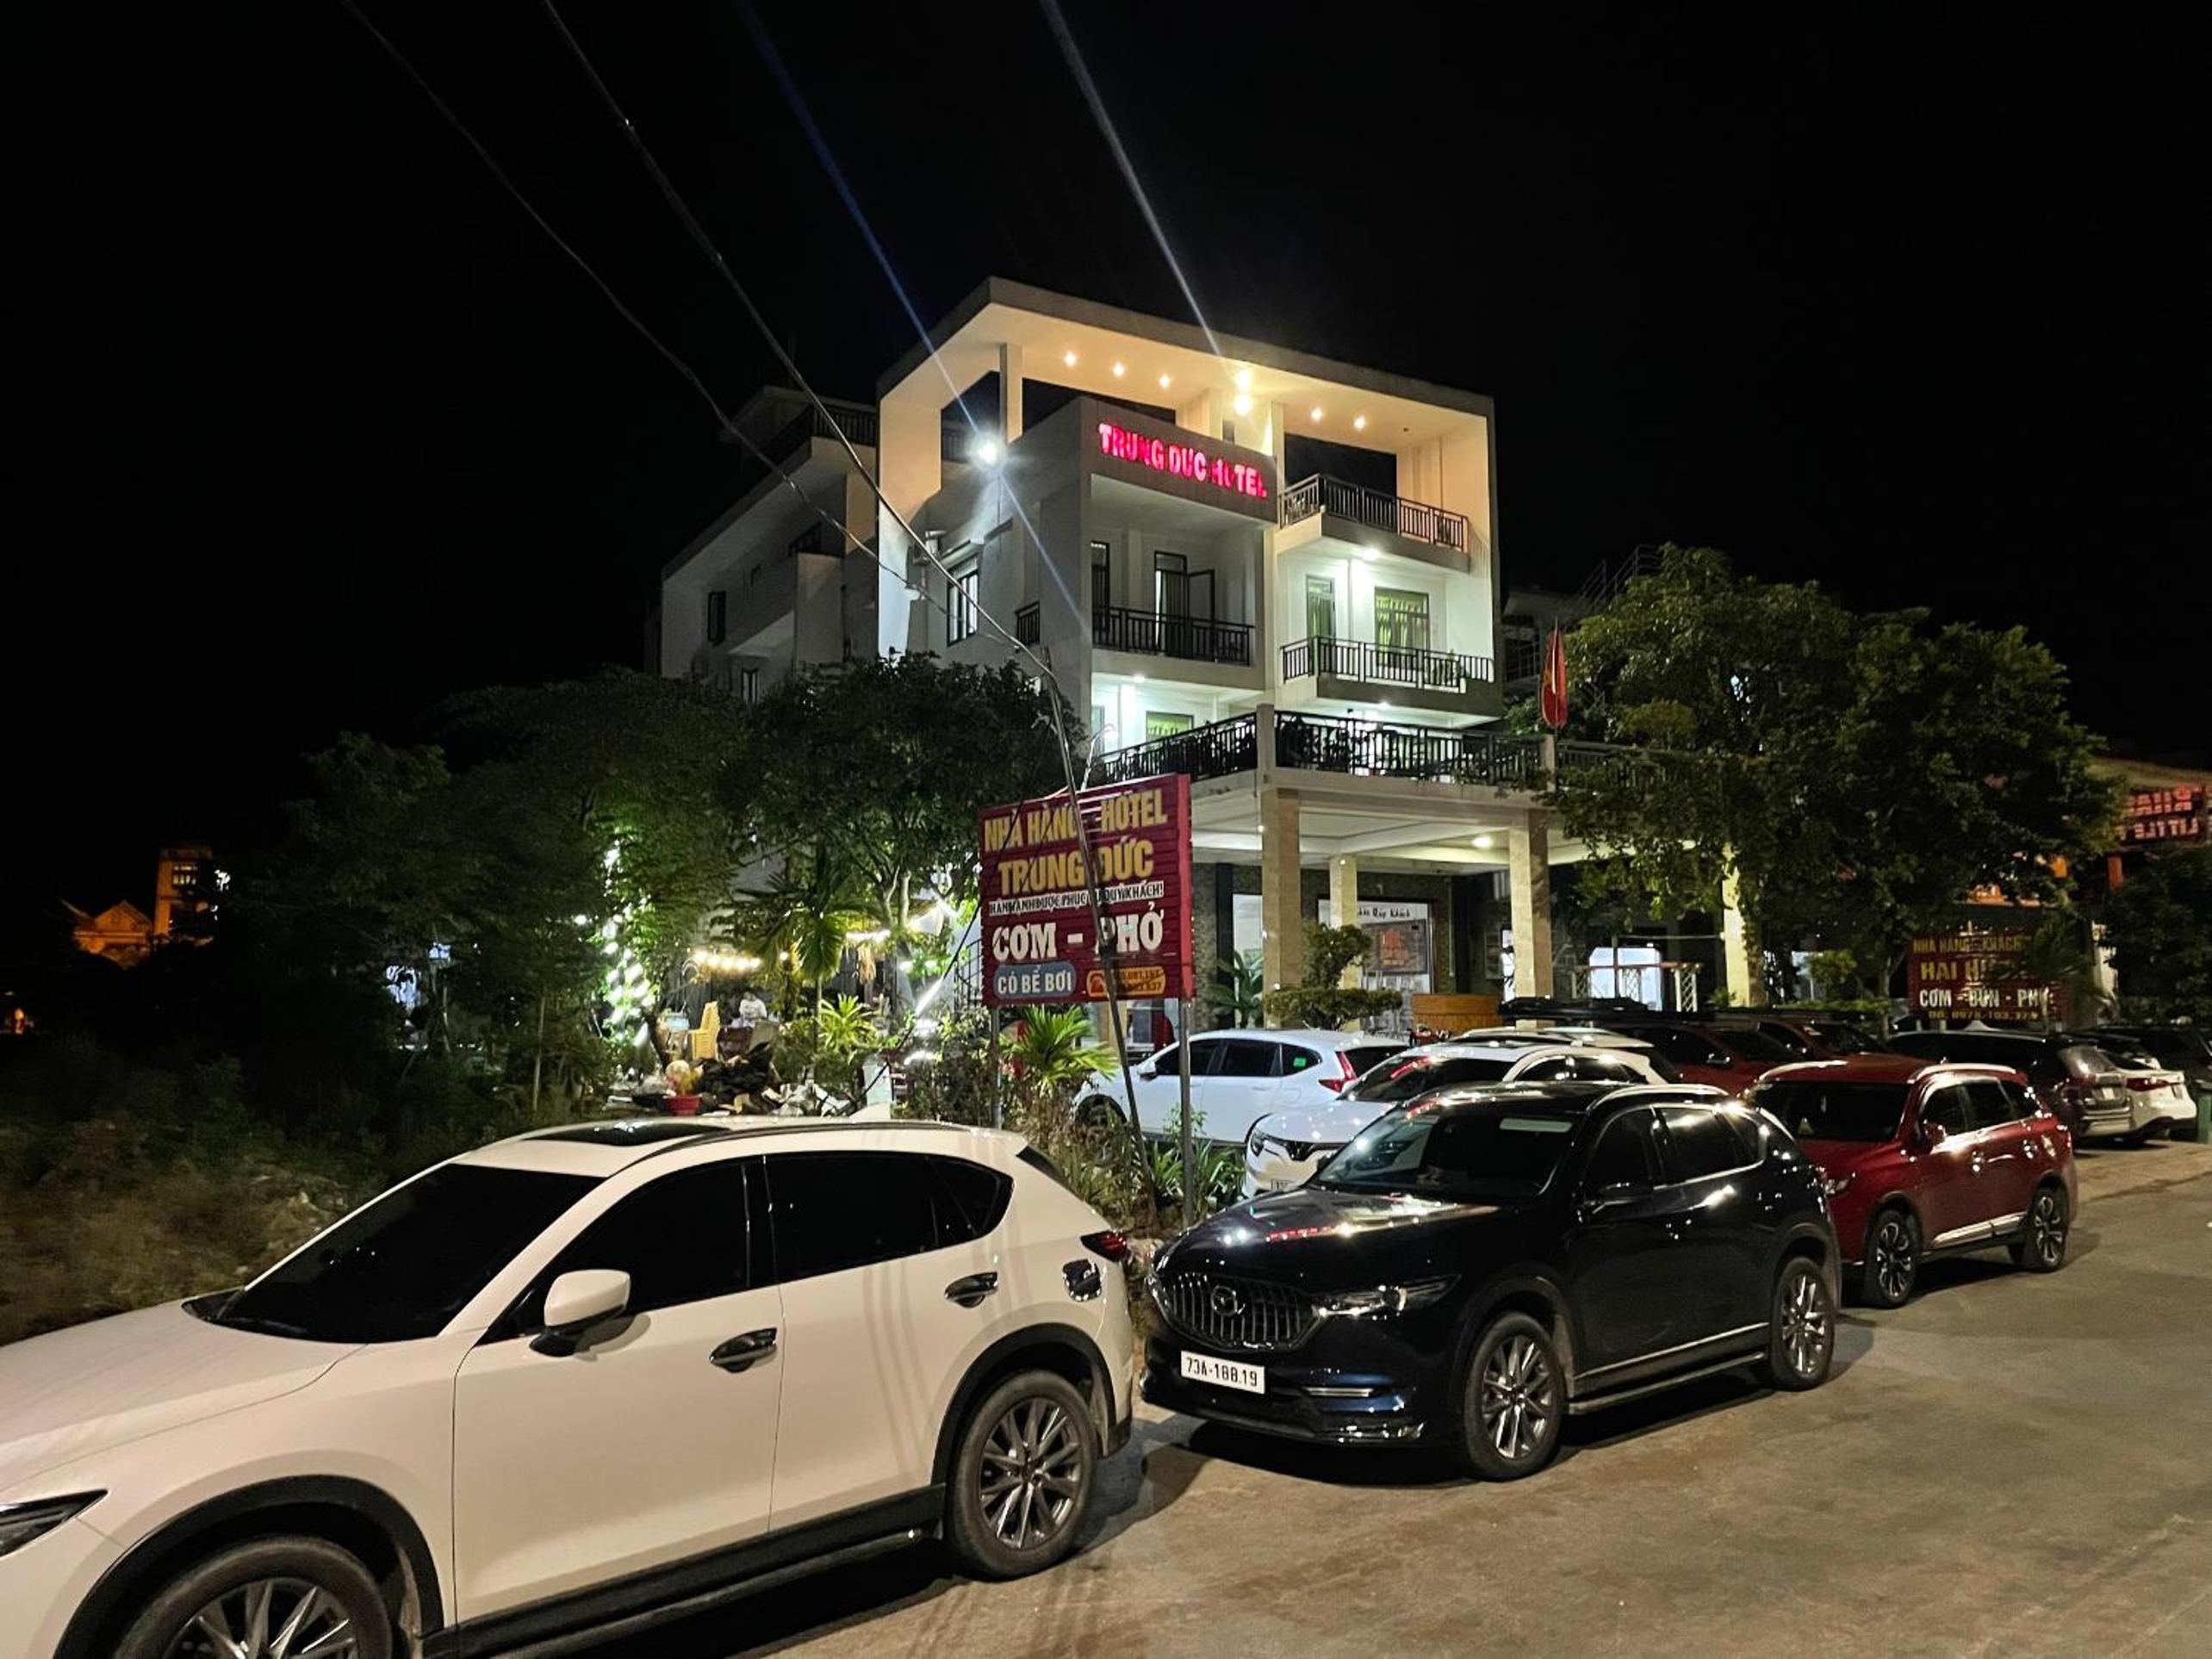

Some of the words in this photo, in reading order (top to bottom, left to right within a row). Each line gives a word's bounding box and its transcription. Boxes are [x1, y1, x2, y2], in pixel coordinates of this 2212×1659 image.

[1099, 423, 1164, 470] TRUNG
[985, 809, 1023, 852] NHÀ
[1100, 789, 1168, 834] HOTEL
[998, 849, 1085, 896] TRUNG
[992, 923, 1057, 961] CƠM
[1067, 933, 1083, 942] -
[997, 971, 1017, 994] CÓ
[1045, 970, 1072, 991] BƠI
